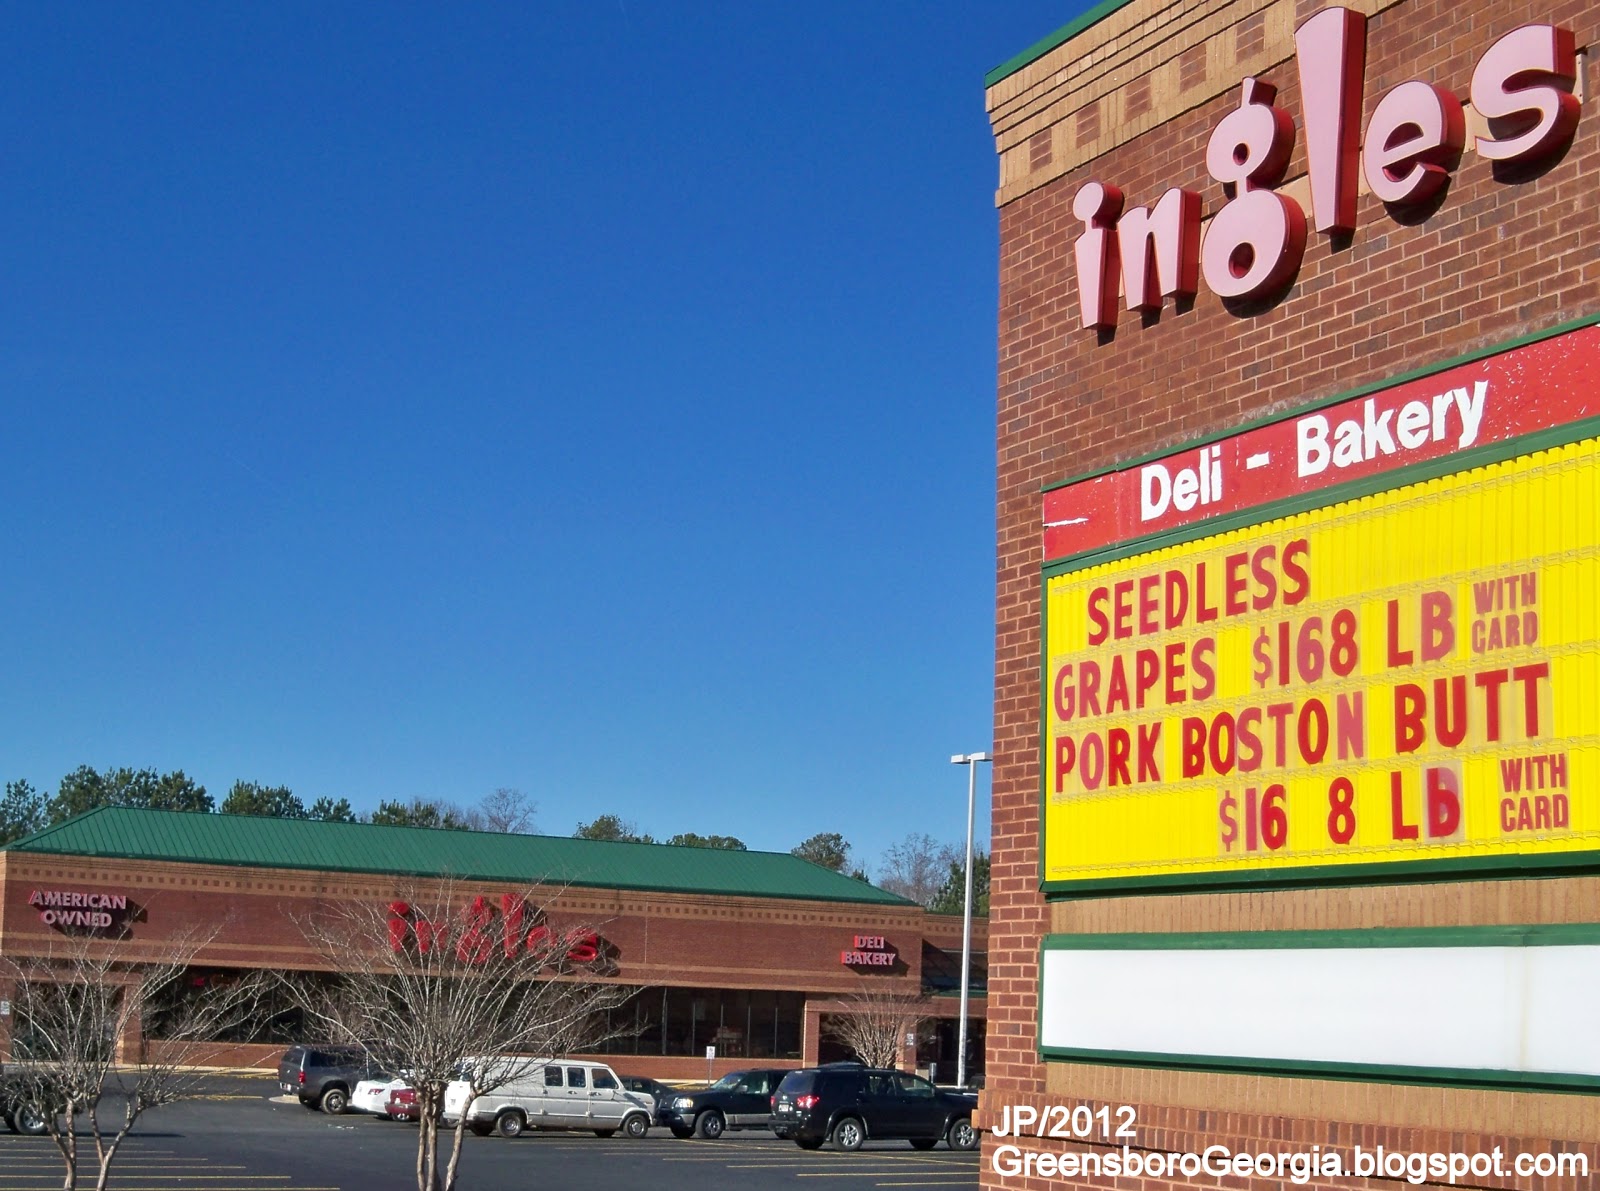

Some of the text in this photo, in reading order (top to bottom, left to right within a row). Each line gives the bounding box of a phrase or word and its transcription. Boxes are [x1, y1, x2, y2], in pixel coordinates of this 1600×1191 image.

[1073, 6, 1581, 330] ingles
[1139, 444, 1222, 521] Deli
[1296, 380, 1489, 477] Bakery
[1087, 538, 1310, 646] SEEDLESS
[1472, 572, 1537, 615] WITH
[1471, 611, 1538, 654] CARD
[1053, 590, 1455, 721] GRAPES $168 LB
[1055, 662, 1549, 793] PORK BOSTON BUTT
[1500, 753, 1566, 793] WITH
[1500, 793, 1569, 832] CARD
[29, 890, 127, 910] AMERICAN
[40, 909, 112, 927] OWNED
[841, 951, 896, 966] BAKERY
[853, 935, 885, 949] DELI
